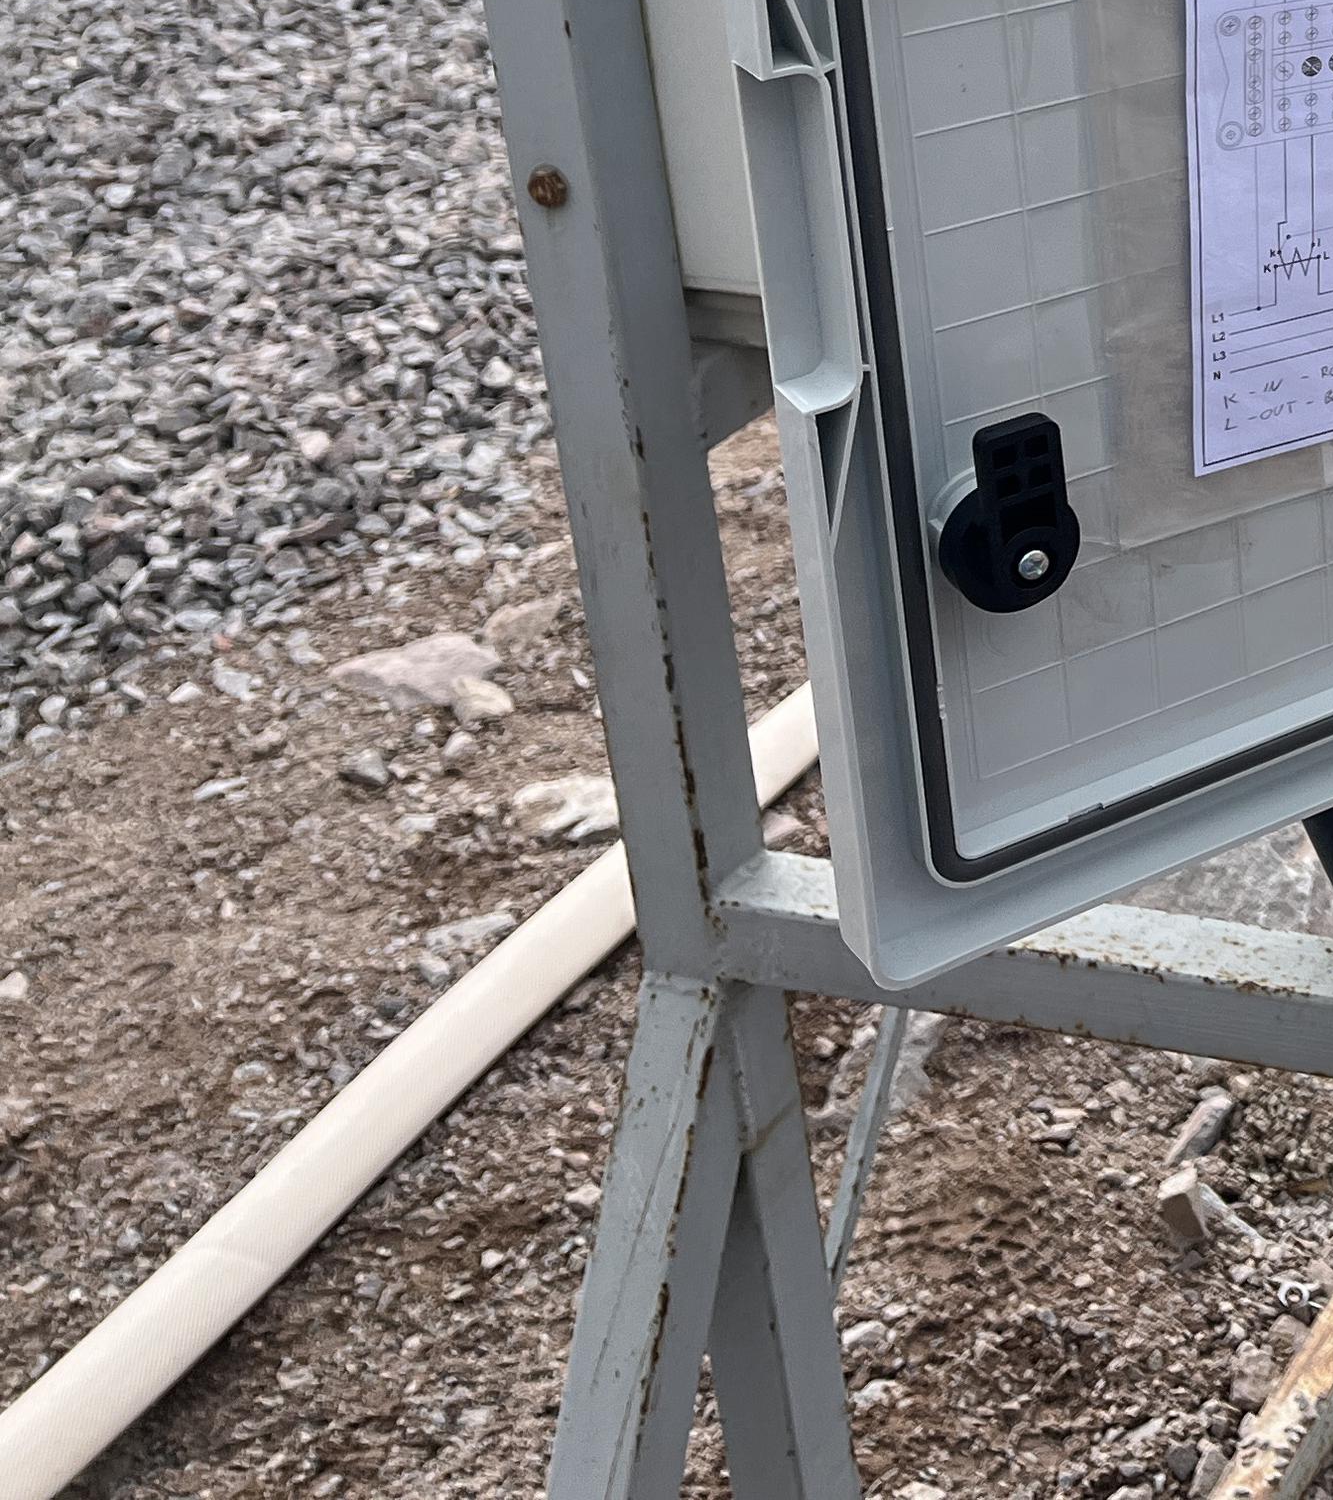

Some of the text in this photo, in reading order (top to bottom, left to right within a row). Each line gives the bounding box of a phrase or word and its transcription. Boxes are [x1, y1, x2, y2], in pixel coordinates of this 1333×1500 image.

[1211, 312, 1225, 324] L1
[1212, 331, 1226, 343] L2
[1213, 351, 1227, 362] L3
[1213, 371, 1221, 381] N
[1223, 393, 1238, 409] K
[1263, 379, 1283, 392] IN
[1223, 417, 1238, 431] L
[1259, 401, 1298, 421] OUT
